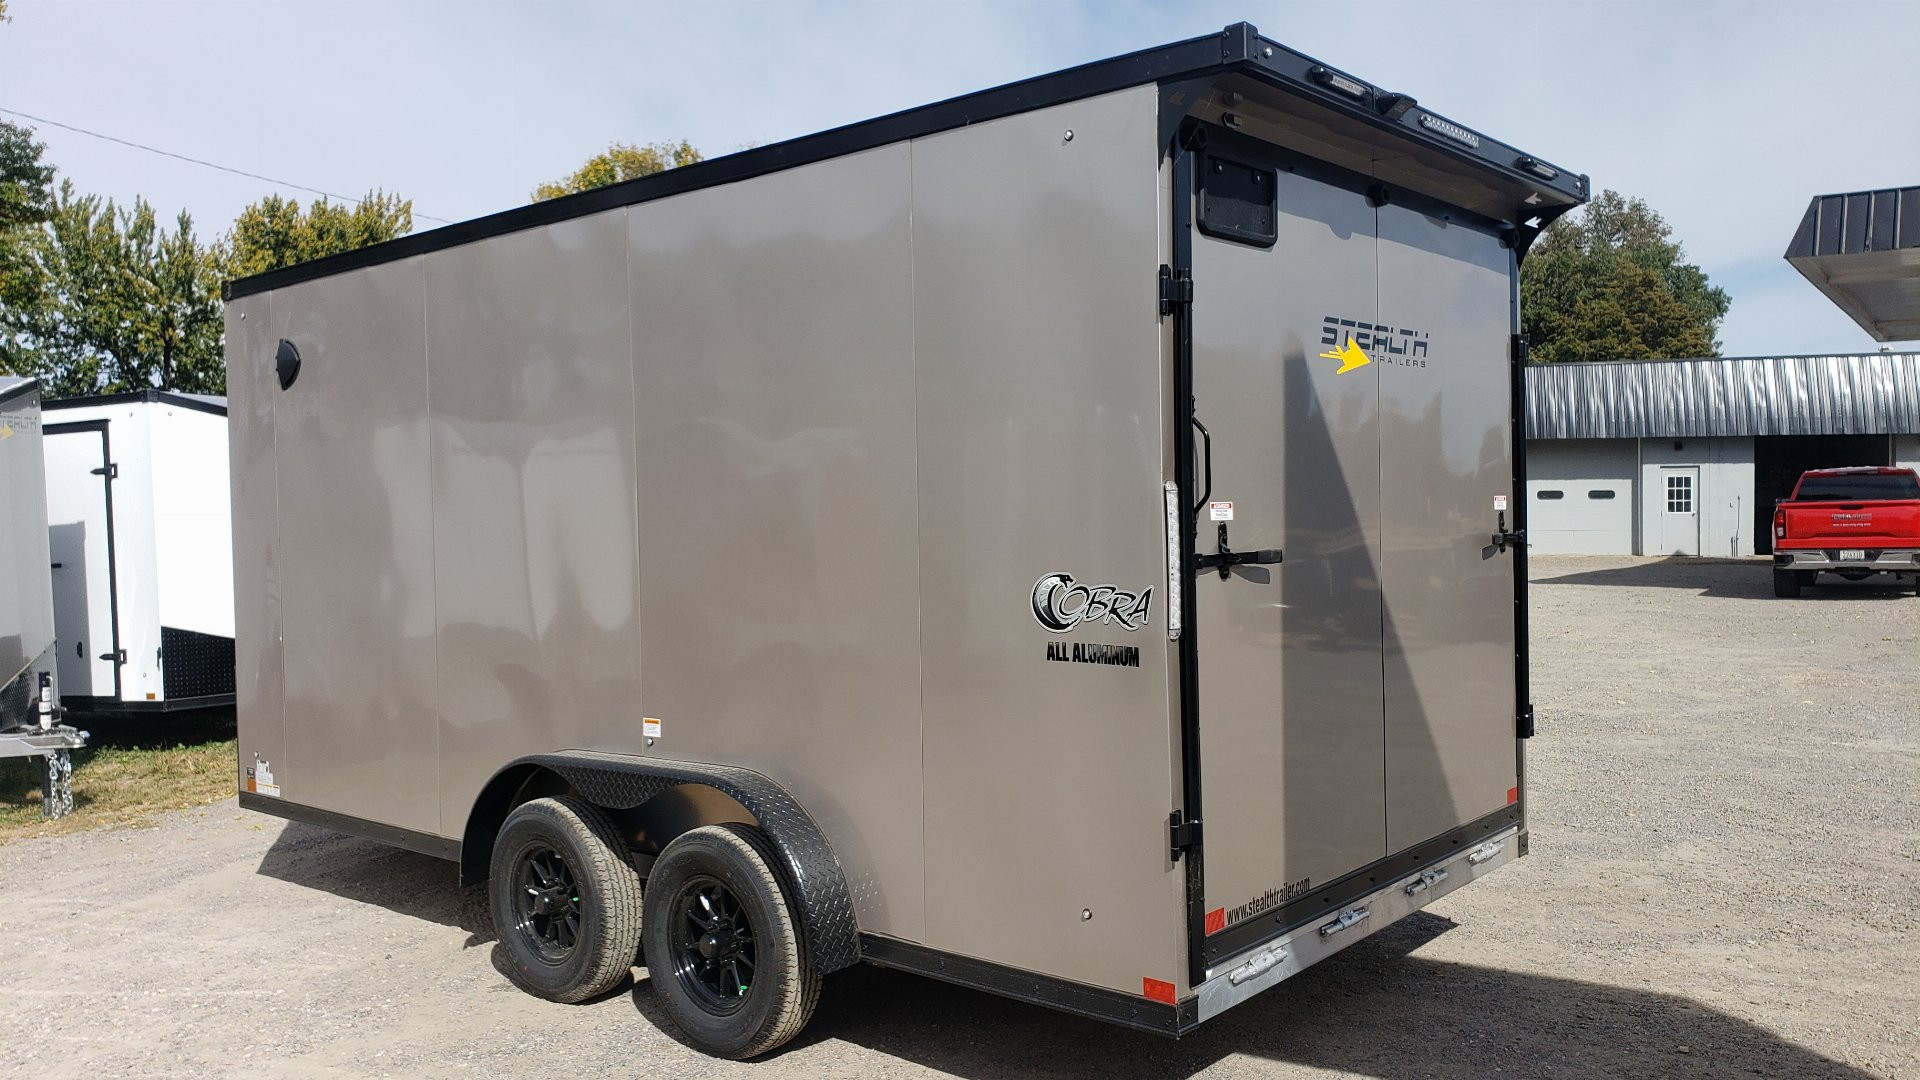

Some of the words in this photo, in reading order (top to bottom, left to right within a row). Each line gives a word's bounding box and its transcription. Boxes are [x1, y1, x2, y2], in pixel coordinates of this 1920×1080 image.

[1321, 316, 1429, 358] STEALTH
[1371, 354, 1426, 368] TRAILERS
[0, 415, 37, 430] TEALTH
[1030, 572, 1155, 633] COBRA
[1046, 641, 1070, 662] ALL
[1072, 642, 1140, 667] ALUMINUM
[1226, 877, 1310, 925] www.stealthtrailer.com
